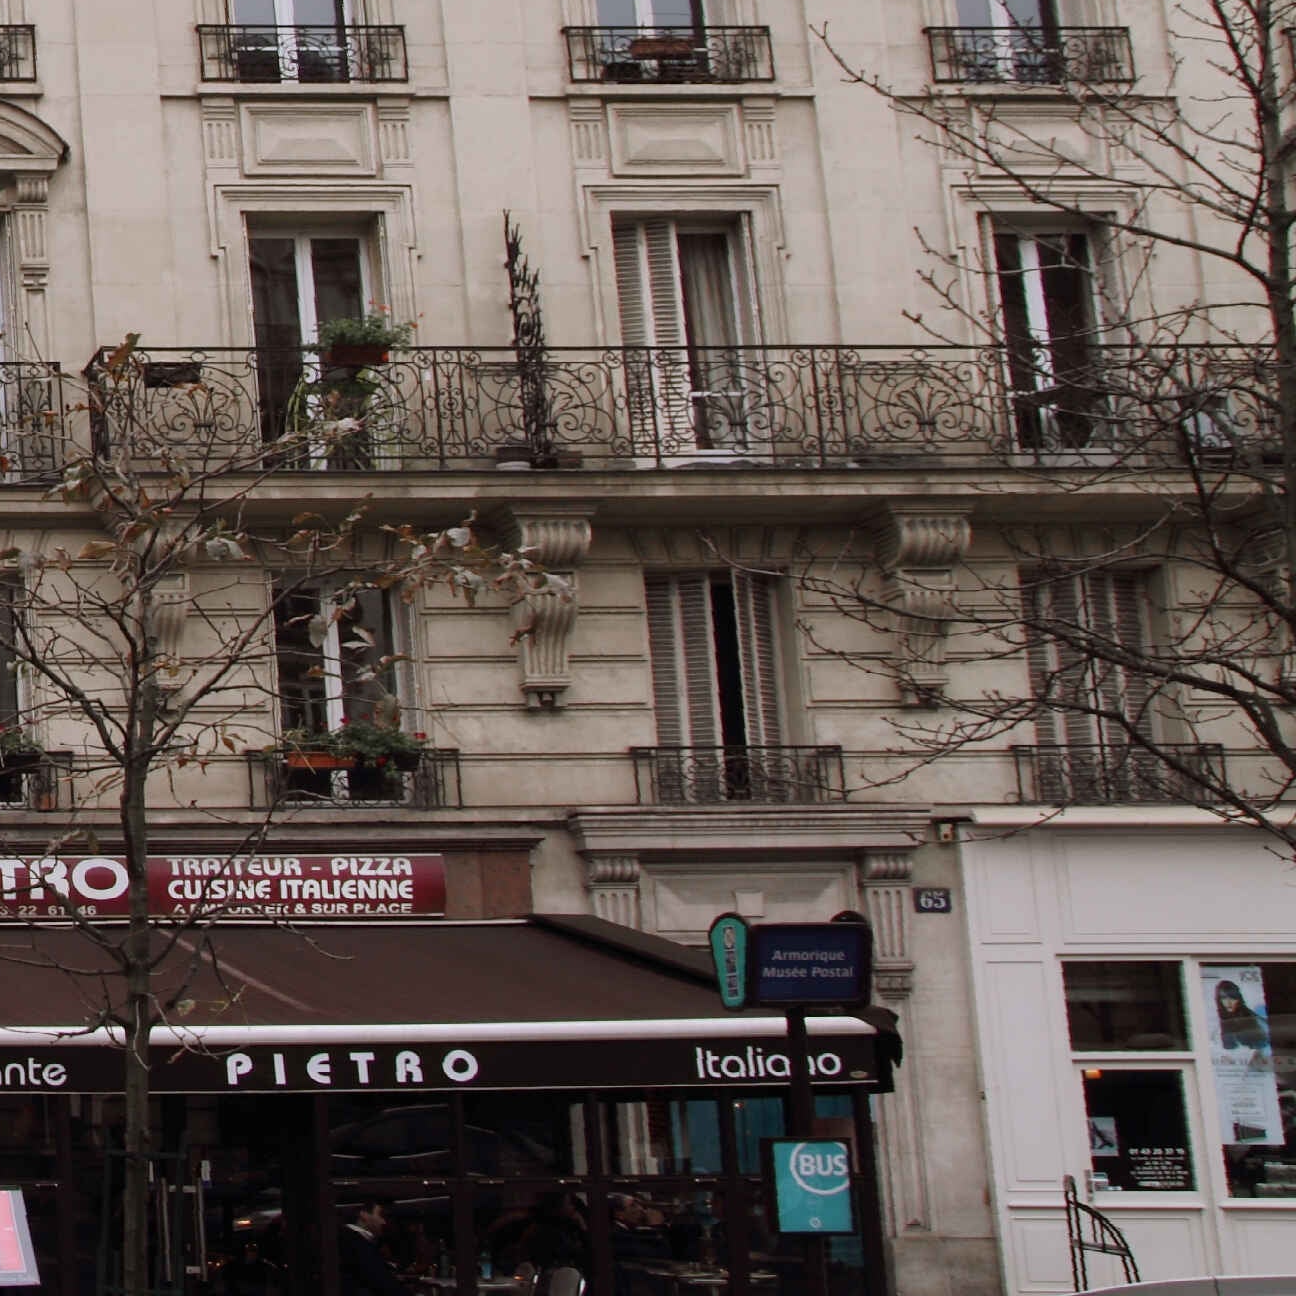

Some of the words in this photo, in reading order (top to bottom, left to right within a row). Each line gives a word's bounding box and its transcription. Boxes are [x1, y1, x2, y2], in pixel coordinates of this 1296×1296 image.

[167, 857, 303, 877] TRAITEUR
[331, 857, 414, 877] PIZZA
[167, 879, 272, 900] CUISINE
[280, 879, 414, 900] ITALIENNE
[293, 903, 307, 915] &
[311, 903, 347, 915] SUR
[352, 903, 413, 915] PLACE
[920, 891, 946, 909] 65
[18, 905, 37, 916] 22
[77, 905, 97, 916] 46
[771, 950, 846, 963] Armorique
[762, 966, 808, 978] Musée
[812, 966, 854, 978] Postal
[226, 1049, 480, 1086] PIETRO
[798, 1154, 849, 1177] BUS
